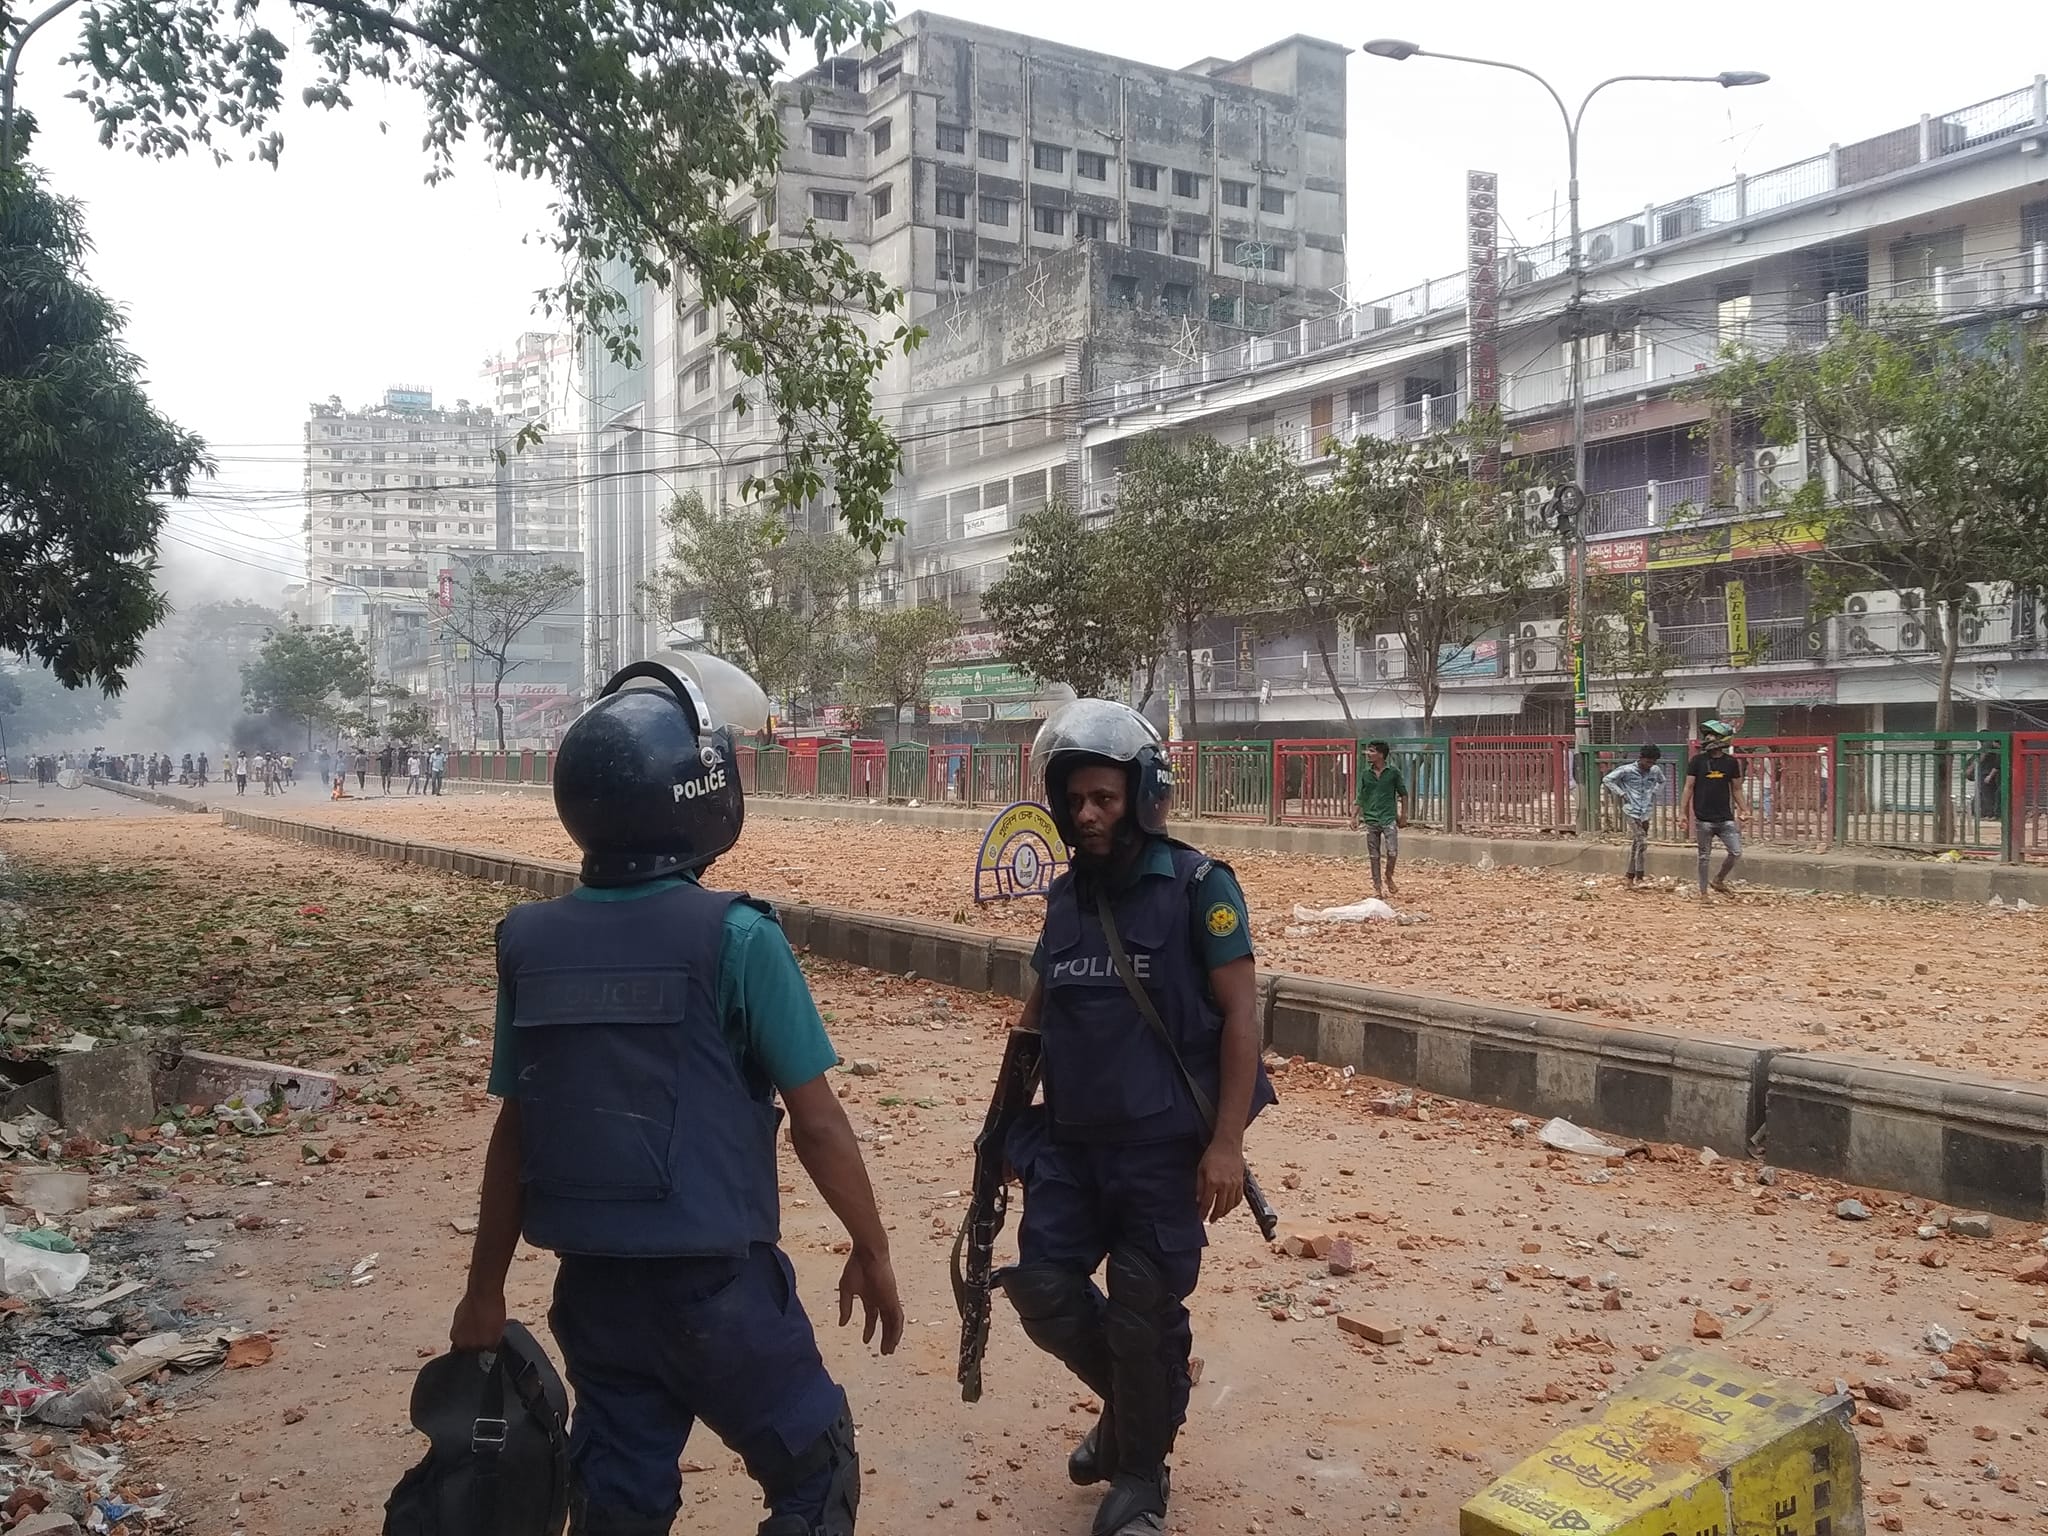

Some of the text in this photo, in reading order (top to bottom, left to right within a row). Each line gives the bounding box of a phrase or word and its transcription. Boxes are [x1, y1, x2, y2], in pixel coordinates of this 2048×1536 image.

[1731, 600, 1745, 653] Faith
[520, 683, 559, 694] Bata
[673, 772, 727, 802] POLICE
[1018, 810, 1034, 821] চেক
[1544, 1453, 1657, 1503] ট্রাফিক
[1488, 1485, 1560, 1521] BSRM
